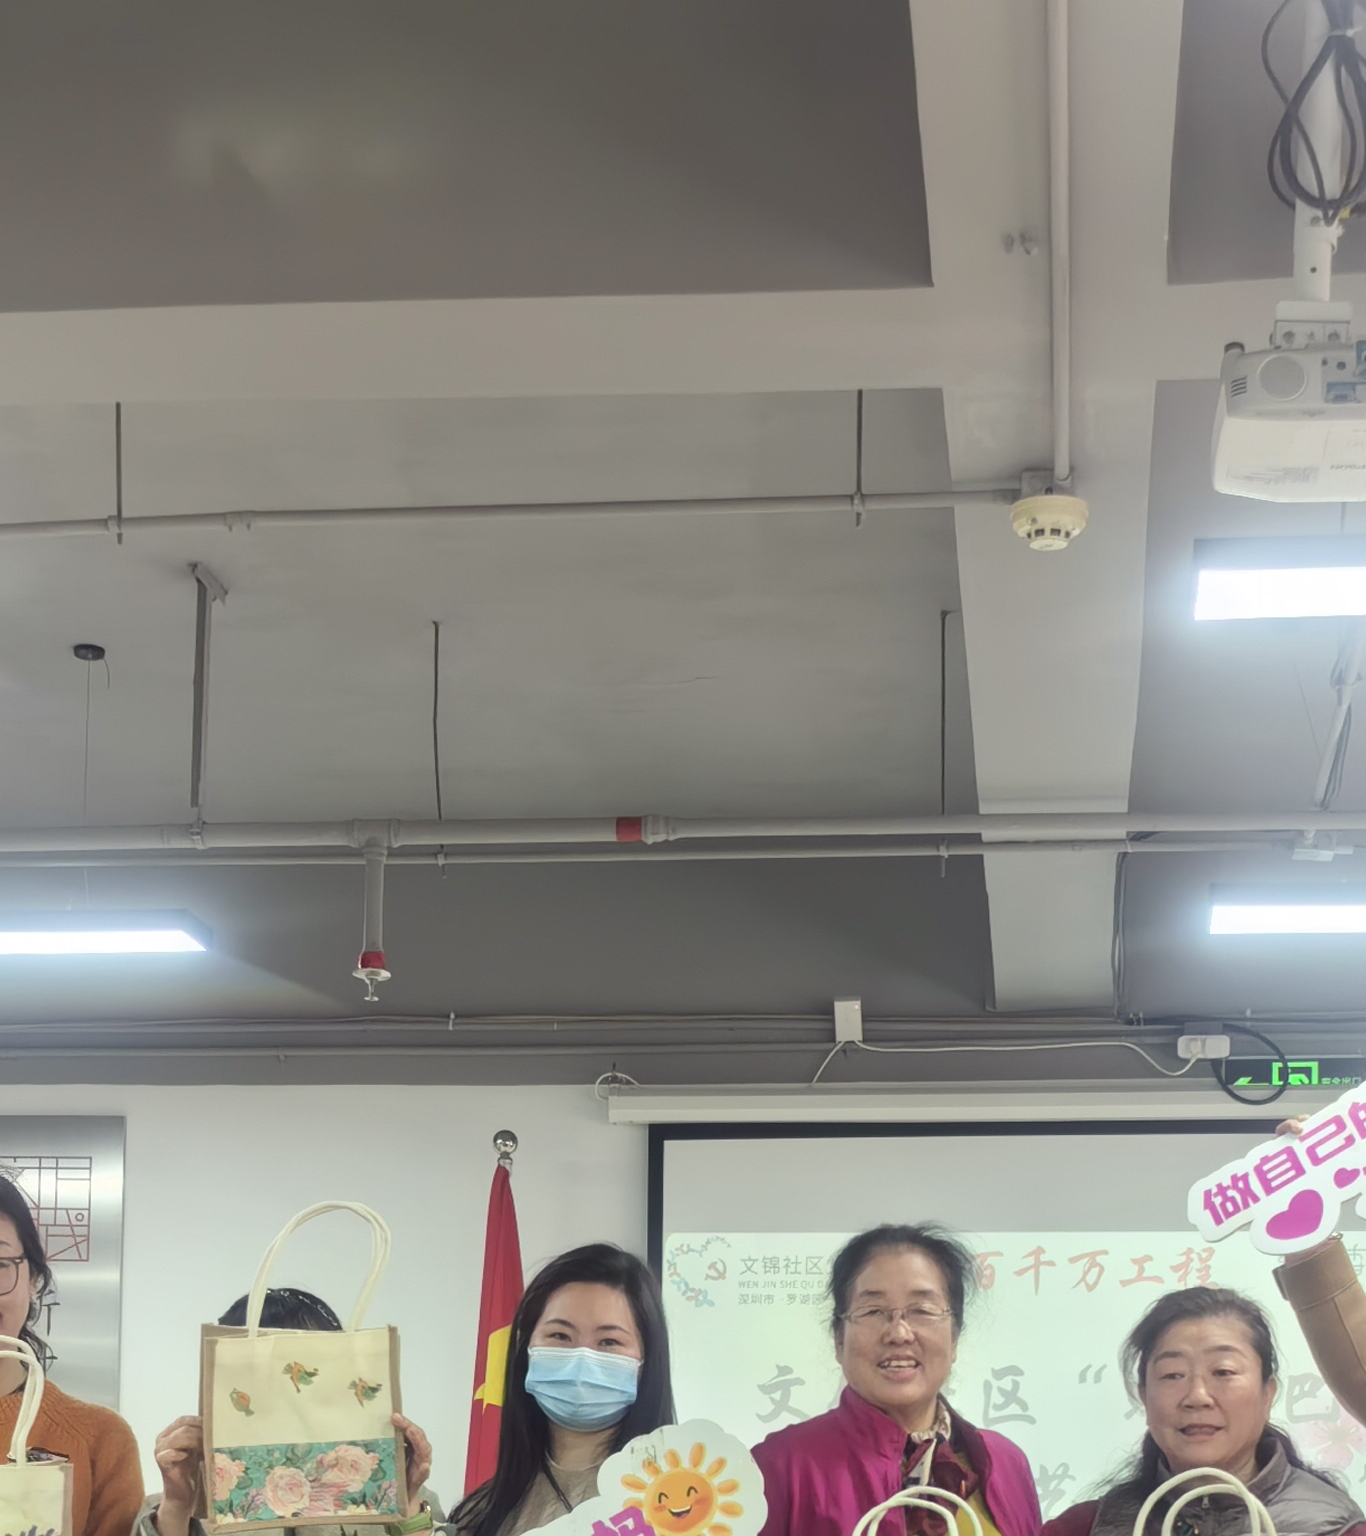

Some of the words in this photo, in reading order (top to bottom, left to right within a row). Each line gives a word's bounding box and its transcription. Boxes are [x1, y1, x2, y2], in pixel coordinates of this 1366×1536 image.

[739, 1254, 833, 1276] 文锦社区
[738, 1280, 758, 1289] WEN
[762, 1280, 777, 1289] JIN
[780, 1280, 798, 1289] SHE
